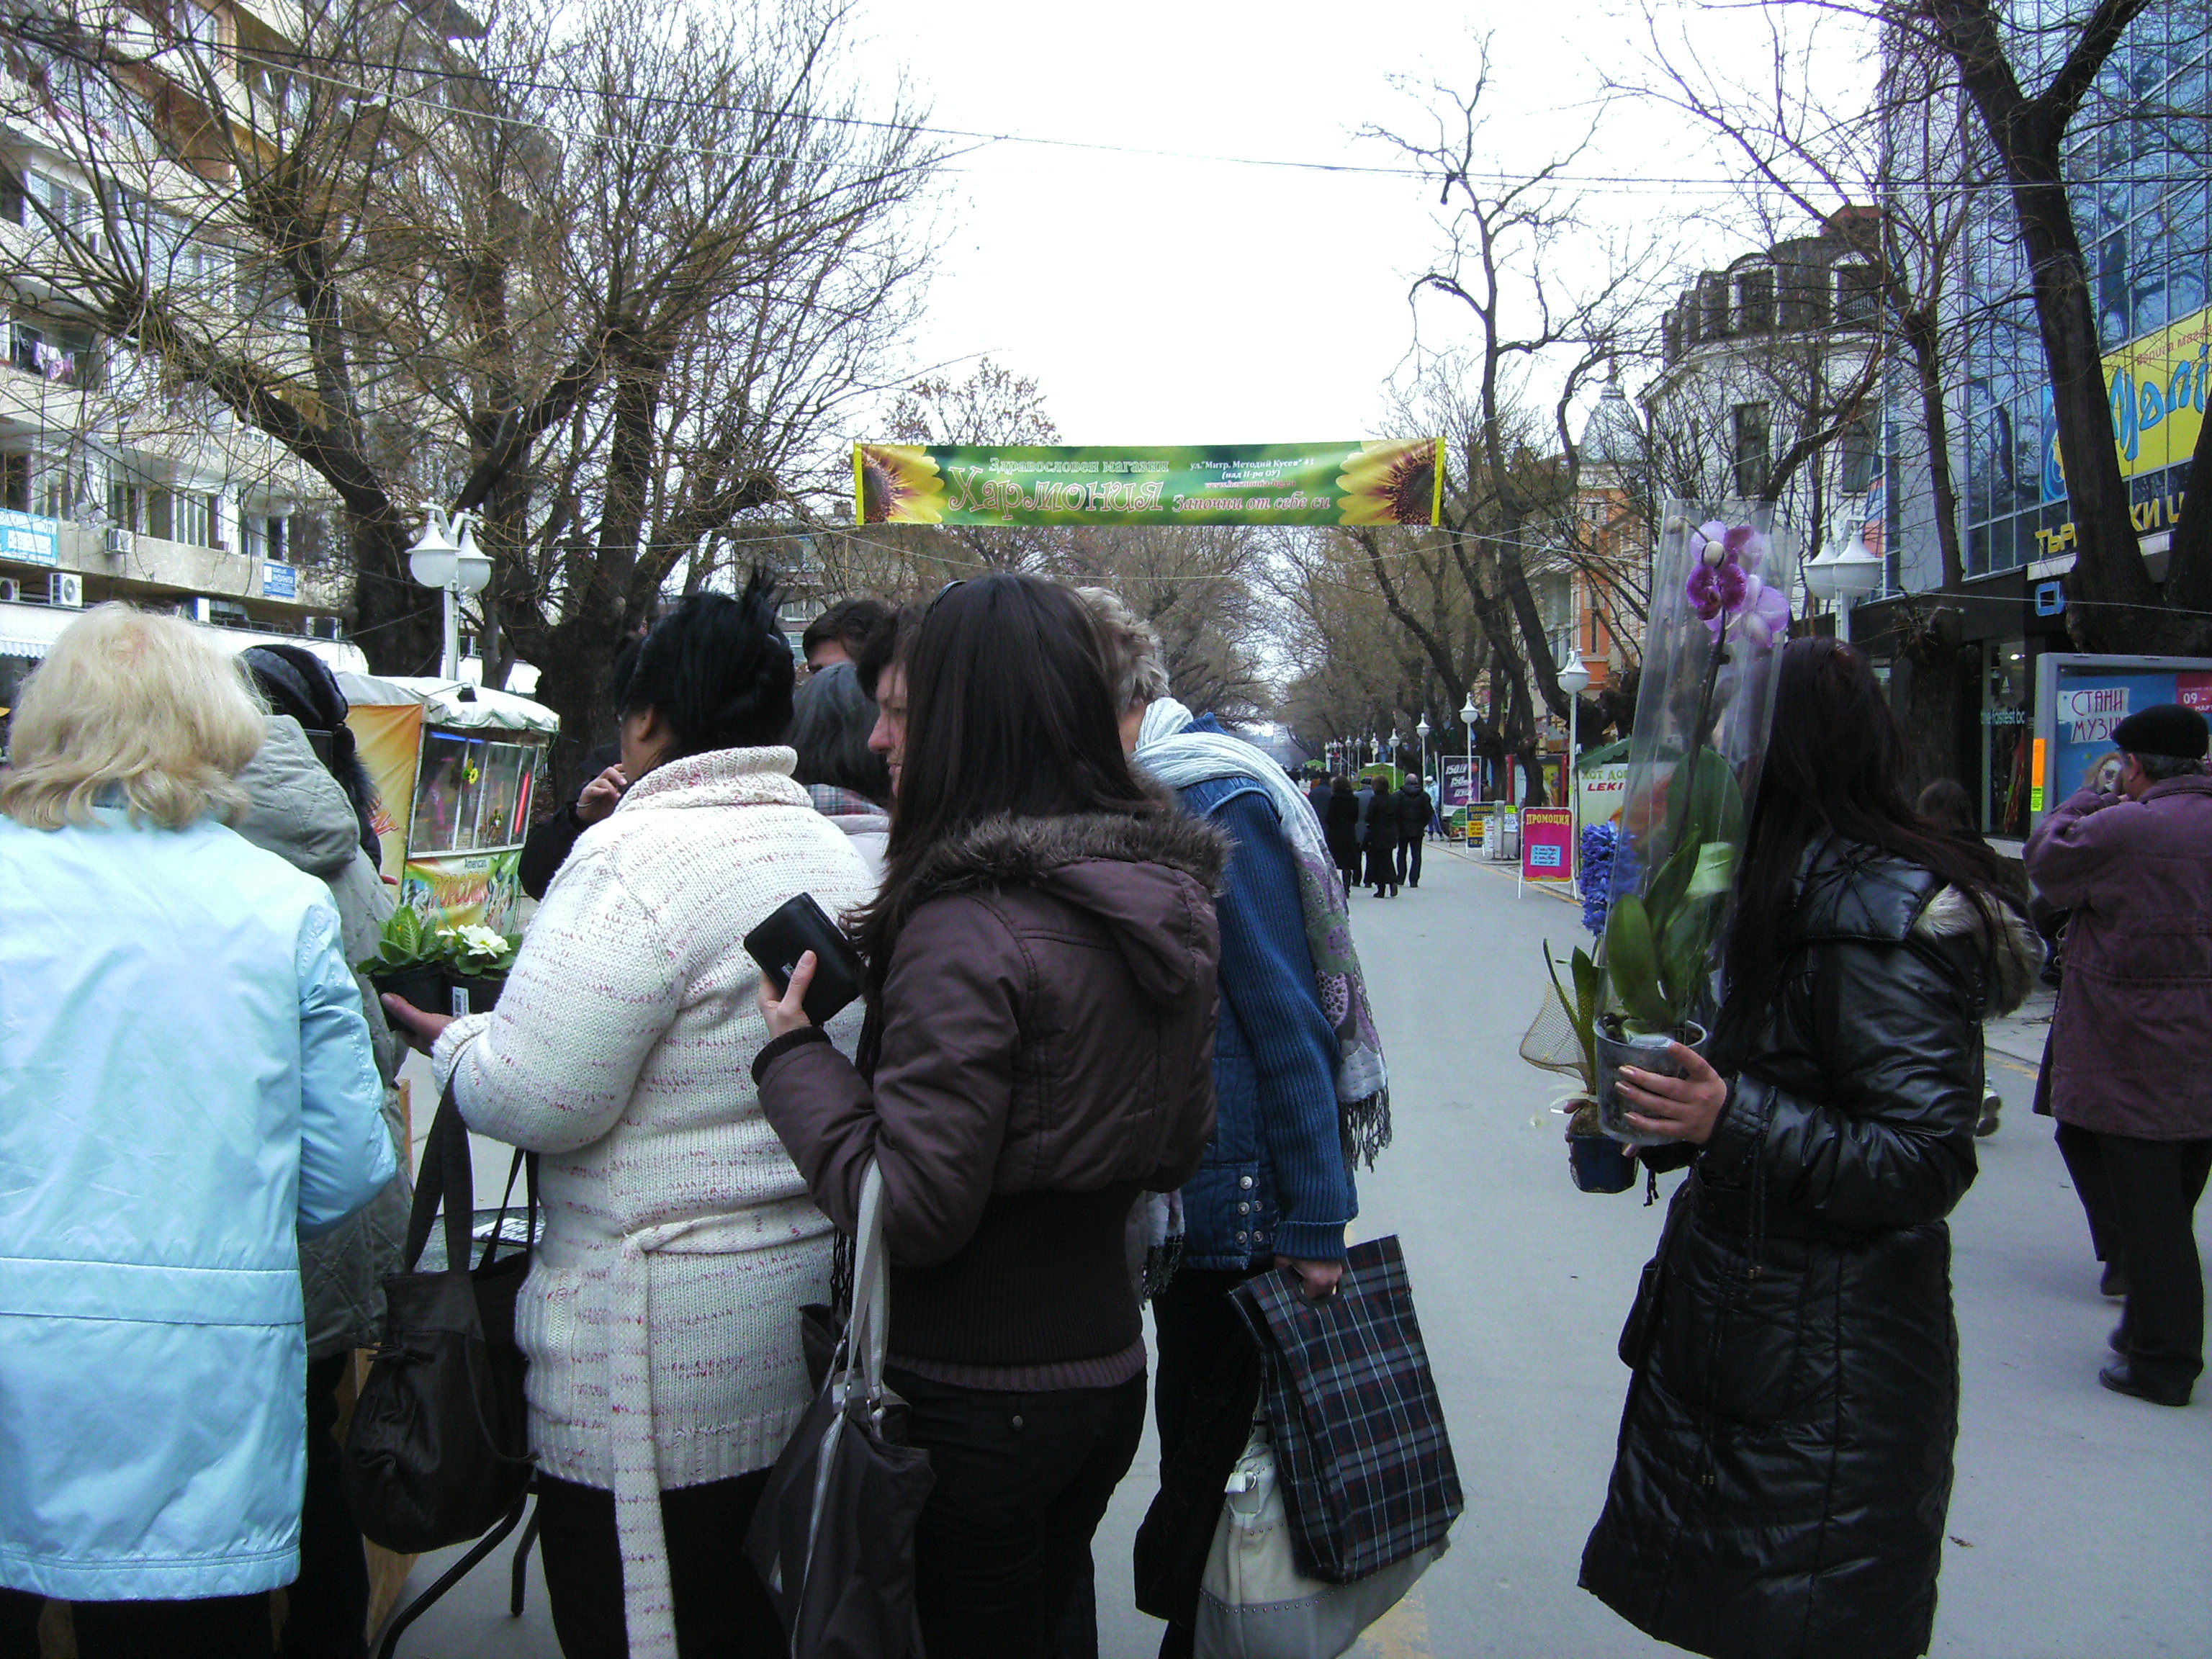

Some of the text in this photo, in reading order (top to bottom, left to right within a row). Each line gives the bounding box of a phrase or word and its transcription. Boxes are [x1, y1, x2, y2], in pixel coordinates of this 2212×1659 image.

[989, 457, 1169, 473] Здравословен магазин
[948, 466, 1164, 520] Хармония
[1172, 491, 1331, 512] Започни от себе си
[2183, 693, 2198, 703] 09
[1527, 814, 1570, 825] ПРОМОЦИЯ
